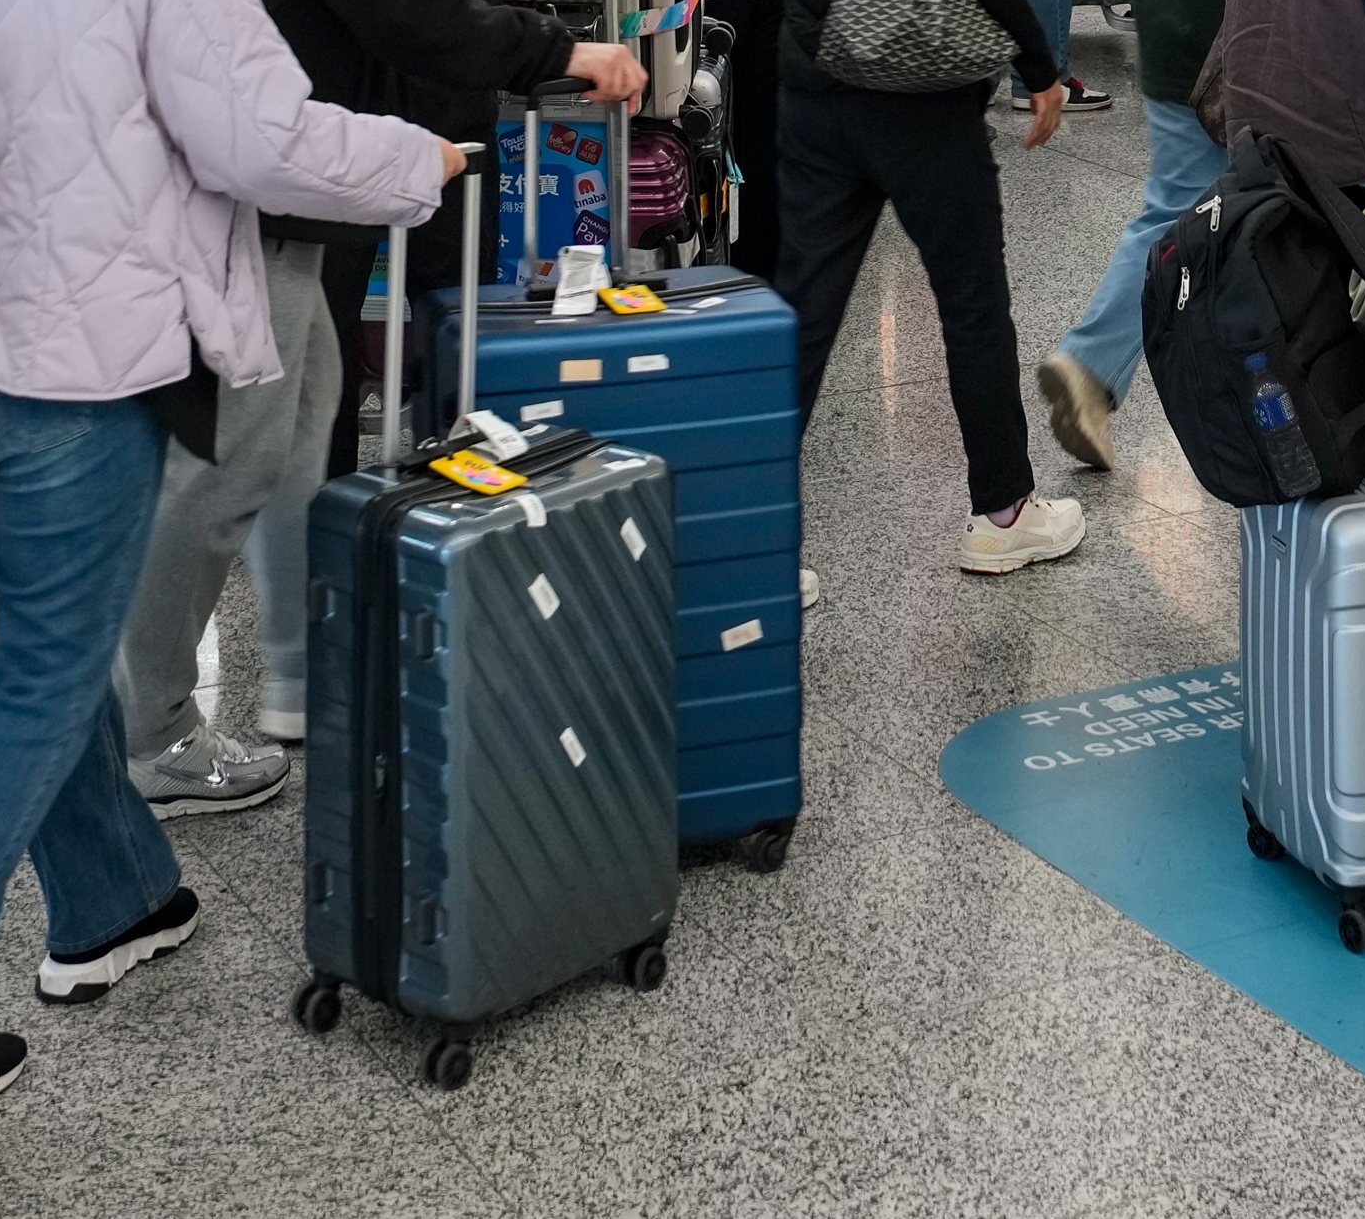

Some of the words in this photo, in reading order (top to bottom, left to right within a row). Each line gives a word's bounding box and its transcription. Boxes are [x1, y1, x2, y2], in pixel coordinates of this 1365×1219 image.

[500, 134, 526, 149] Touc
[576, 222, 604, 246] Pay
[582, 216, 608, 234] CHANGI
[1187, 696, 1235, 716] IN
[1084, 706, 1188, 737] NEED
[1083, 722, 1207, 758] SEATS
[1024, 749, 1085, 770] TO
